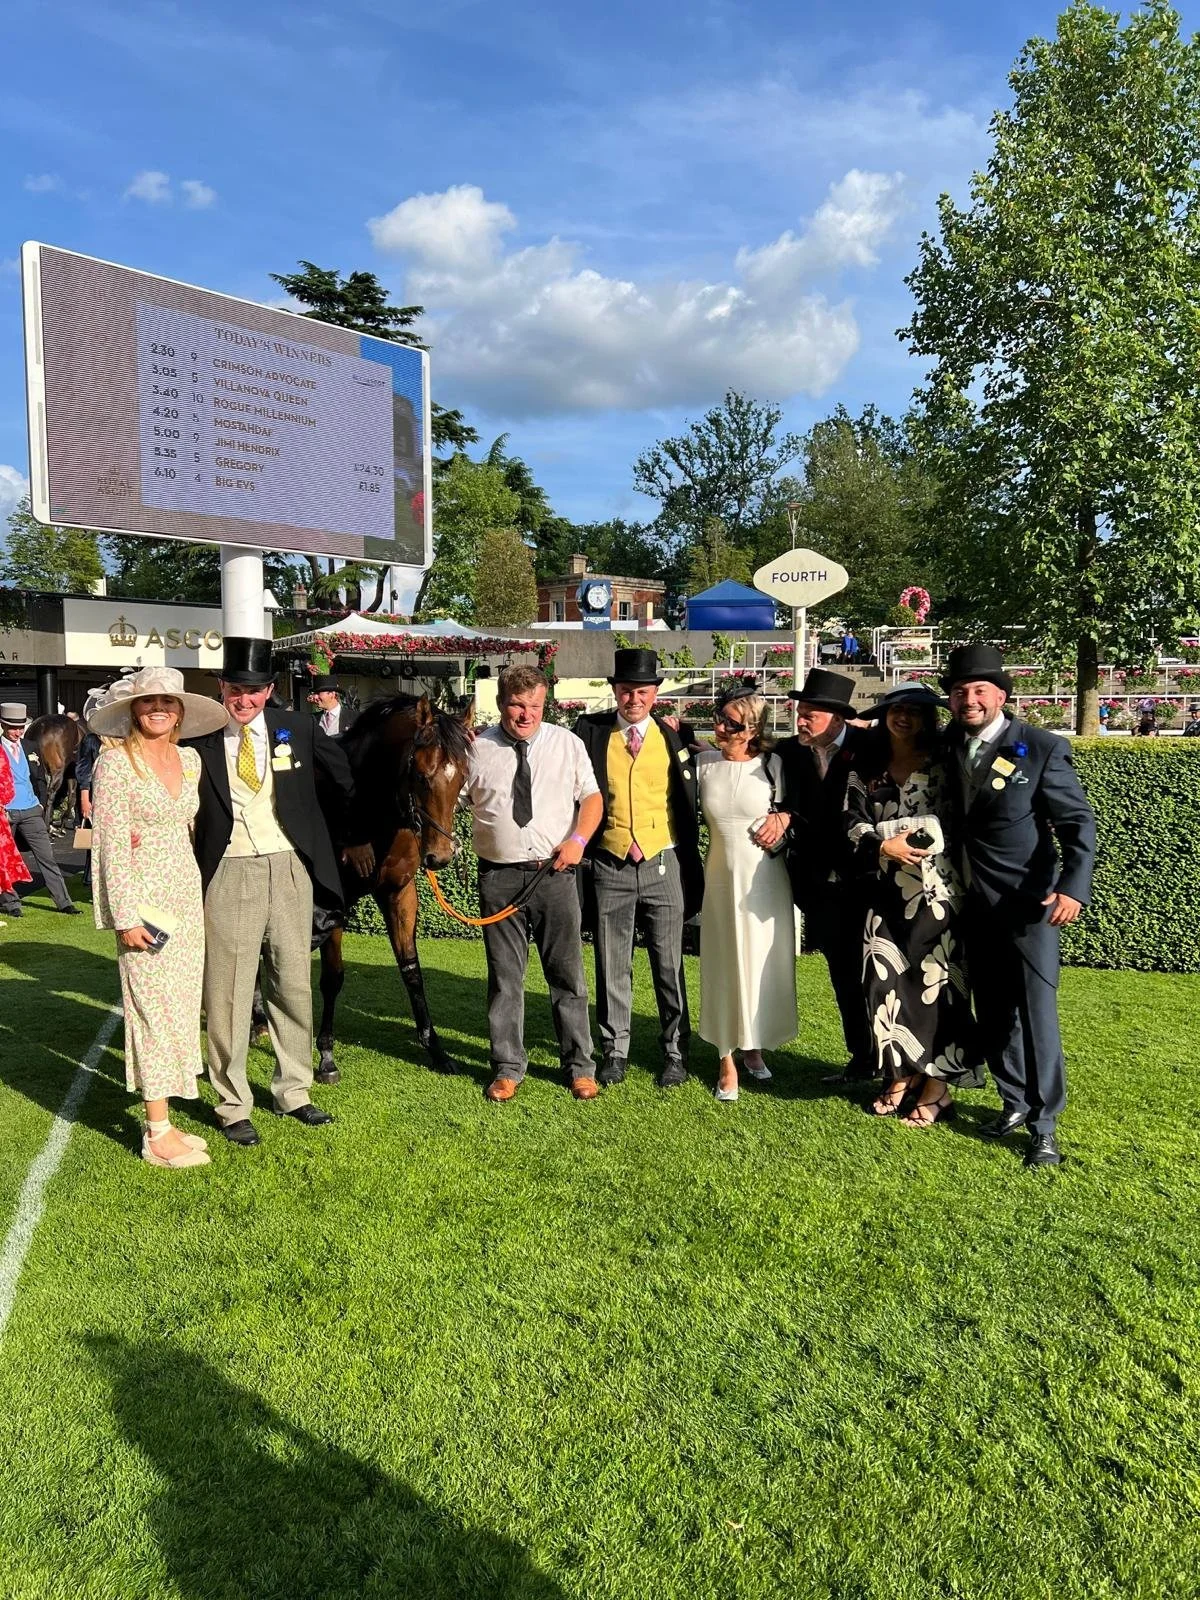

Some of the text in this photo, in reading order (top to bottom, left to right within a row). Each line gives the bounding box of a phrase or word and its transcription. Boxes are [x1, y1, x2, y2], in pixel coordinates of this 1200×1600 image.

[214, 327, 333, 367] TODAY'S WINNERS
[151, 342, 316, 389] 2.30 9 CRIMSON ADVOCATE
[152, 364, 308, 406] 3.05 5 VILLANOVA QUEEN
[152, 384, 317, 427] 3.40 10 ROGUE MILLENNIUM
[153, 406, 179, 419] 4.20
[153, 426, 180, 439] 5.00
[215, 438, 236, 449] JIMI
[239, 440, 280, 456] HENDRIX
[154, 446, 264, 472] 5.35 5 GREGORY
[154, 467, 176, 479] 6.10
[215, 475, 234, 488] BIG
[236, 479, 255, 491] EVS
[771, 570, 827, 583] FOURTH
[144, 627, 223, 650] ASCO
